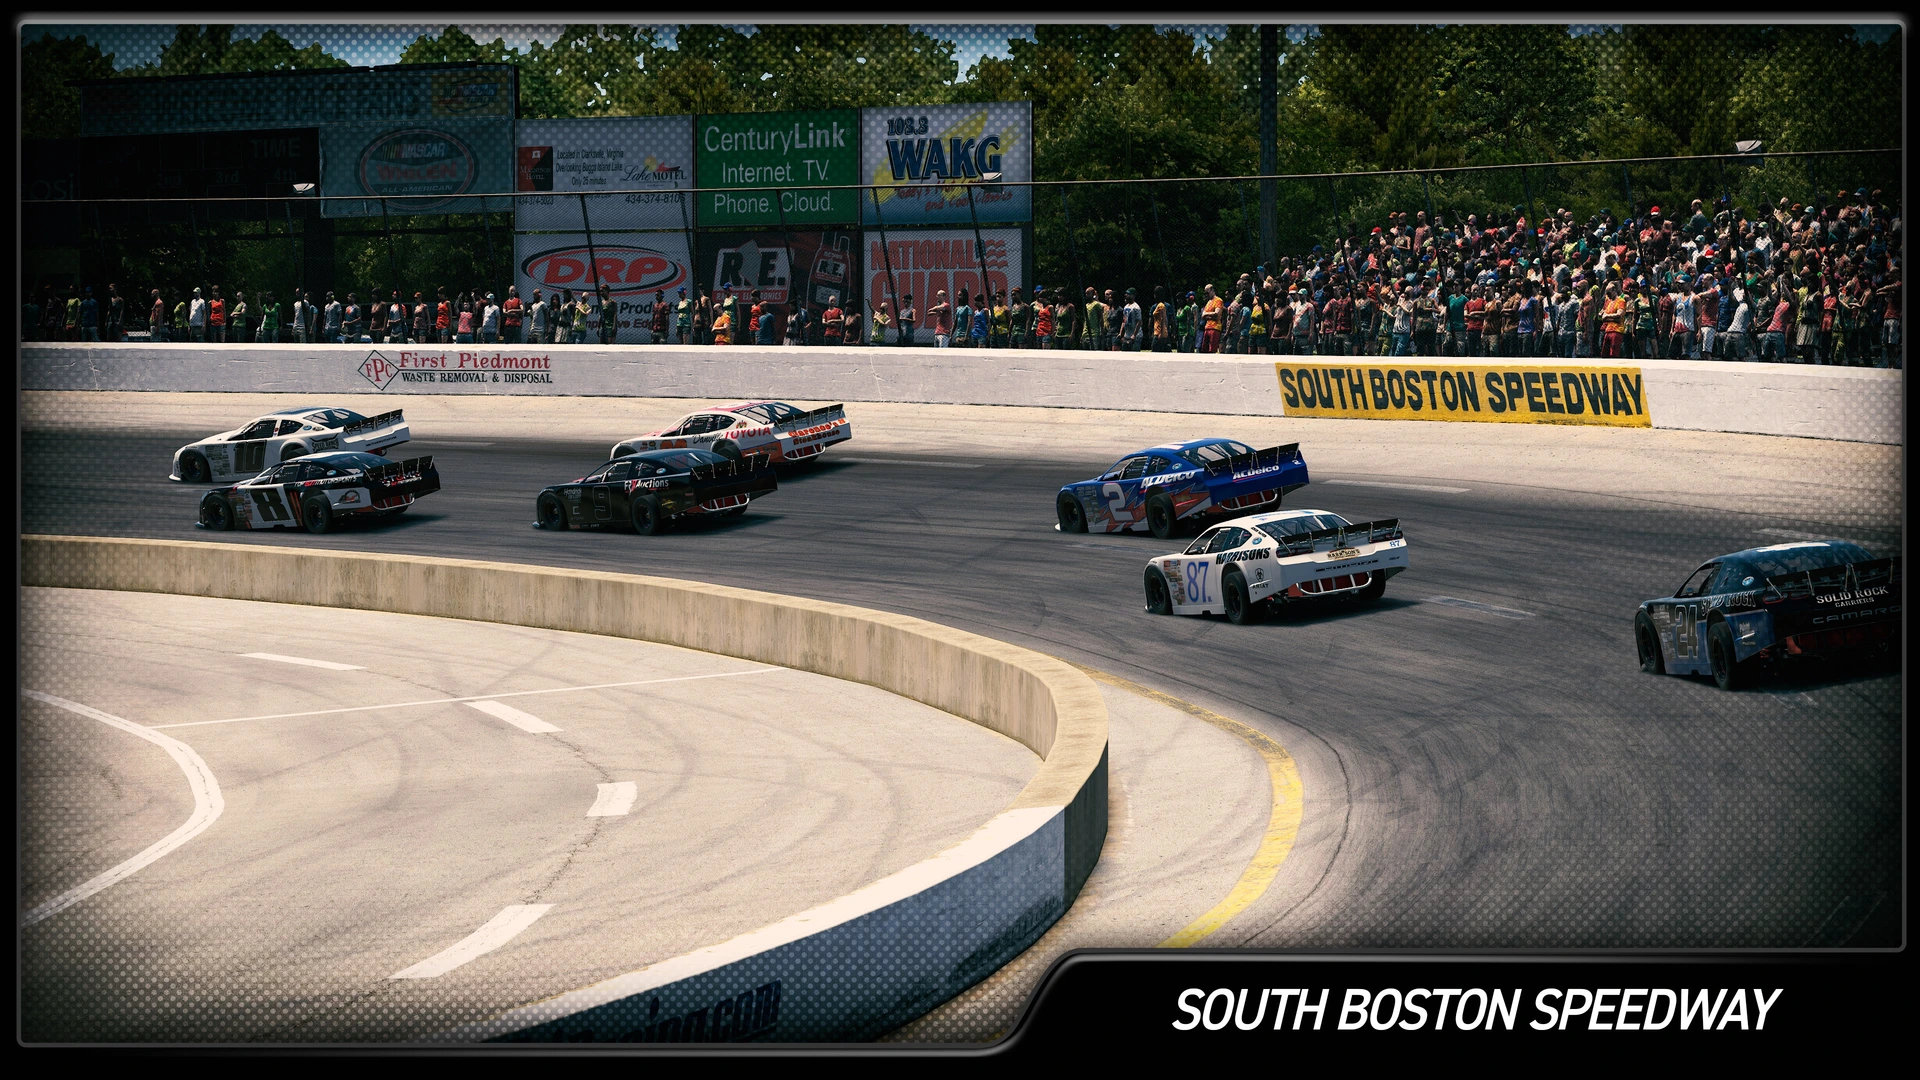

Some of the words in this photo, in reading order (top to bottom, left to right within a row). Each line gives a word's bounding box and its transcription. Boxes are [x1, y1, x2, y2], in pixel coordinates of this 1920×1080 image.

[887, 116, 929, 135] 103.3
[251, 137, 302, 159] TIME
[705, 122, 846, 155] CenturyLink
[402, 143, 446, 159] NASCAR
[885, 135, 1002, 180] WAKG
[376, 161, 458, 182] WHELEN
[620, 164, 652, 181] Lake
[653, 170, 687, 180] MOTEL
[722, 162, 795, 183] Internet.
[803, 159, 829, 181] TV.
[381, 185, 453, 193] ALL-AMERICAN
[714, 193, 773, 213] Phone.
[780, 191, 834, 212] Cloud.
[871, 239, 977, 270] NATIONAL
[543, 257, 668, 284] DRP
[399, 352, 447, 369] First
[458, 352, 551, 369] Piedmont
[402, 372, 436, 383] WASTE
[440, 372, 487, 383] REMOVAL
[492, 373, 499, 382] &
[1280, 368, 1369, 410] SOUTH
[1370, 369, 1481, 412] BOSTON
[1484, 372, 1643, 416] SPEEDWAY
[725, 427, 771, 440] TOYOTA
[1140, 471, 1195, 489] ACDelco
[1233, 465, 1279, 480] ACDelco
[250, 489, 291, 521] 8
[592, 485, 612, 520] 9
[1102, 482, 1134, 521] 2
[1815, 591, 1852, 604] SOLID
[1854, 585, 1889, 599] ROCK
[1834, 596, 1875, 608] CARRIERS
[1812, 605, 1903, 625] CAMARO
[1675, 605, 1698, 658] 24
